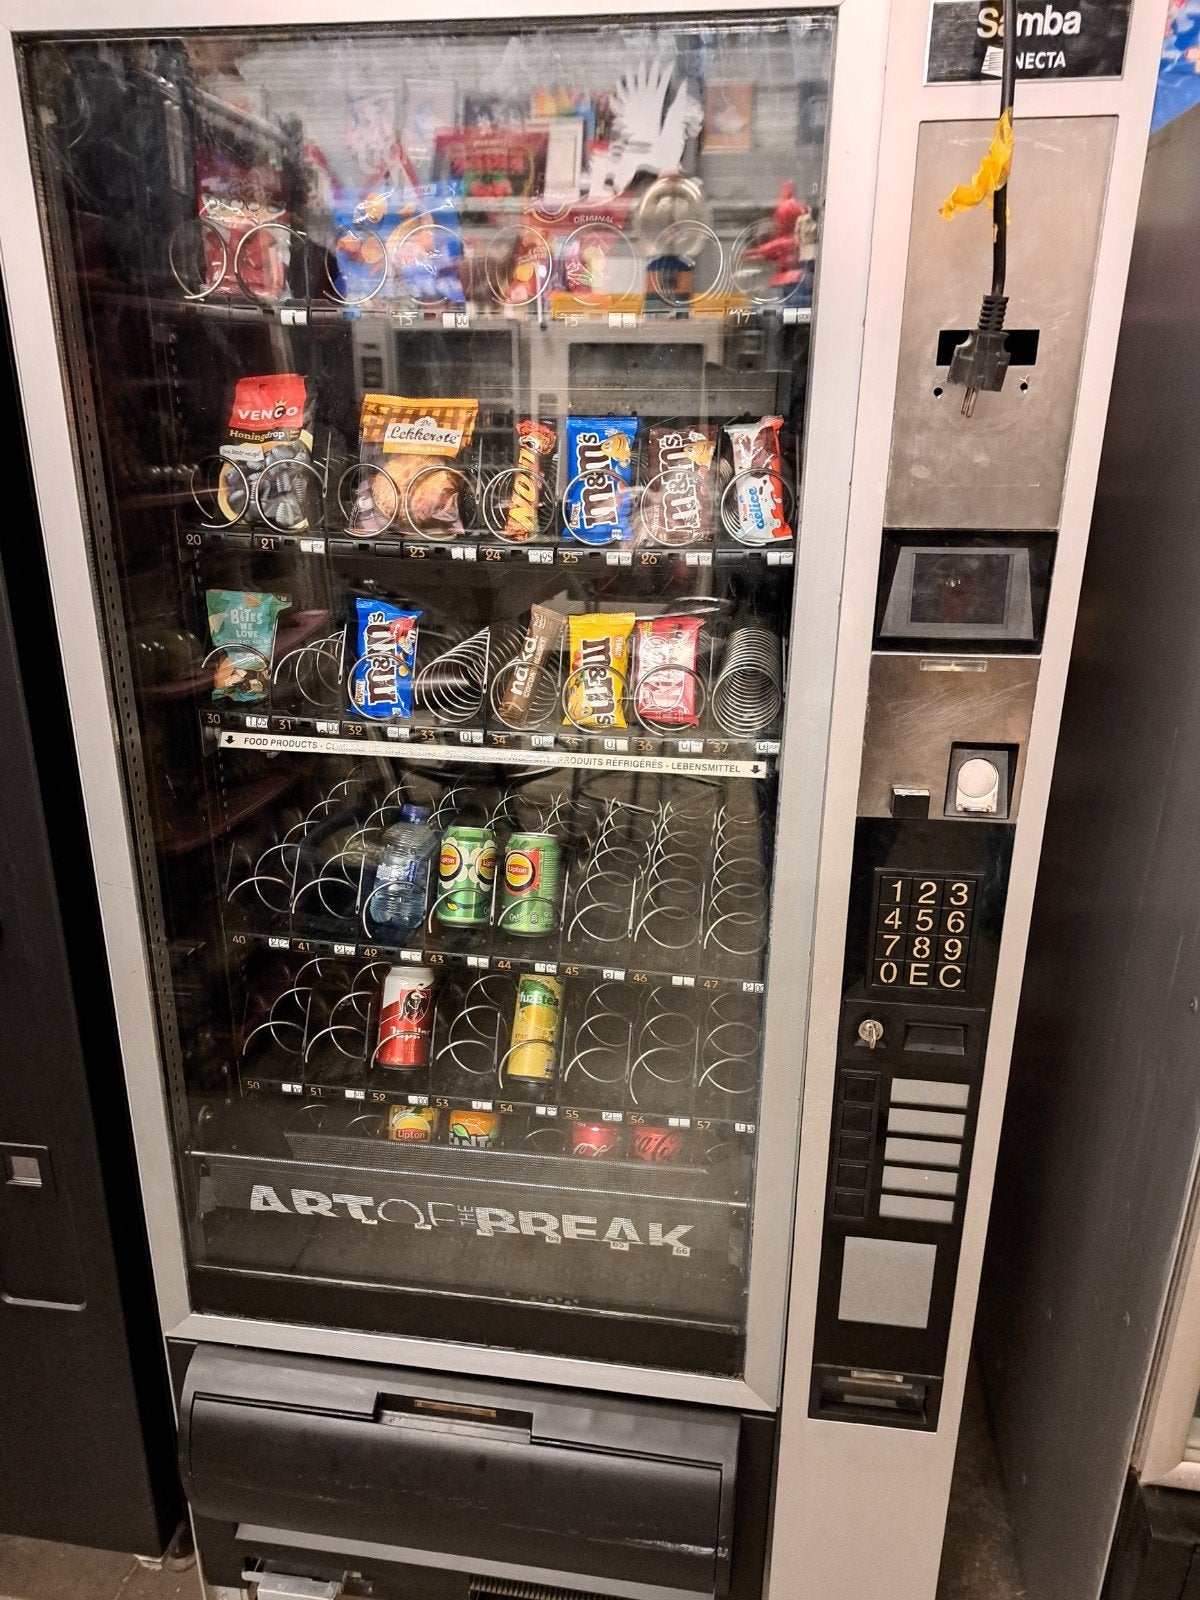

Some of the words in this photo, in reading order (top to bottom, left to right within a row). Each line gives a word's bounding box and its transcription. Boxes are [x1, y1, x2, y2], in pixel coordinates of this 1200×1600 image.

[1015, 51, 1066, 70] NECTA
[573, 214, 614, 224] ORIGINAL
[238, 405, 299, 421] VENCO
[229, 429, 285, 442] Honingdrop
[186, 534, 201, 546] 20
[261, 538, 275, 549] 21
[410, 546, 426, 558] 23
[485, 550, 502, 562] 24
[563, 552, 579, 564] 25
[641, 552, 657, 565] 26
[240, 622, 253, 630] WE
[236, 630, 258, 638] LOVE
[207, 713, 221, 724] 30
[278, 719, 292, 730] 31
[348, 725, 363, 736] 32
[420, 730, 435, 742] 33
[244, 737, 269, 747] FOOD
[270, 739, 318, 750] PRODUCTS
[492, 735, 507, 745] 34
[638, 740, 653, 751] 36
[713, 741, 729, 753] 37
[557, 756, 603, 767] PRODUITS
[605, 757, 663, 769] RÉFRIGÉRÉS
[671, 762, 741, 773] LEBENSMITTEL
[508, 865, 528, 875] Lipton
[892, 880, 902, 902] 1
[918, 881, 937, 904] 2
[949, 882, 969, 906] 3
[884, 907, 902, 930] 4
[915, 909, 934, 932] 5
[947, 911, 965, 933] 6
[232, 935, 246, 945] 40
[298, 942, 310, 951] 41
[883, 935, 901, 956] 7
[912, 936, 931, 959] 8
[943, 938, 962, 960] 9
[363, 948, 378, 957] 42
[429, 954, 444, 964] 43
[498, 960, 512, 969] 44
[565, 966, 579, 976] 45
[880, 961, 898, 984] 0
[909, 963, 930, 986] E
[939, 964, 962, 988] C
[633, 973, 648, 983] 46
[704, 979, 719, 989] 47
[247, 1081, 260, 1090] 50
[310, 1087, 322, 1096] 51
[372, 1093, 386, 1102] 52
[436, 1099, 449, 1108] 53
[500, 1104, 514, 1113] 54
[566, 1110, 579, 1119] 55
[631, 1115, 645, 1125] 56
[697, 1120, 711, 1130] 57
[397, 1129, 425, 1140] Lipton
[250, 1184, 376, 1225] ART
[458, 1205, 475, 1226] THE
[475, 1206, 694, 1249] BREAK
[675, 1247, 689, 1255] 66
